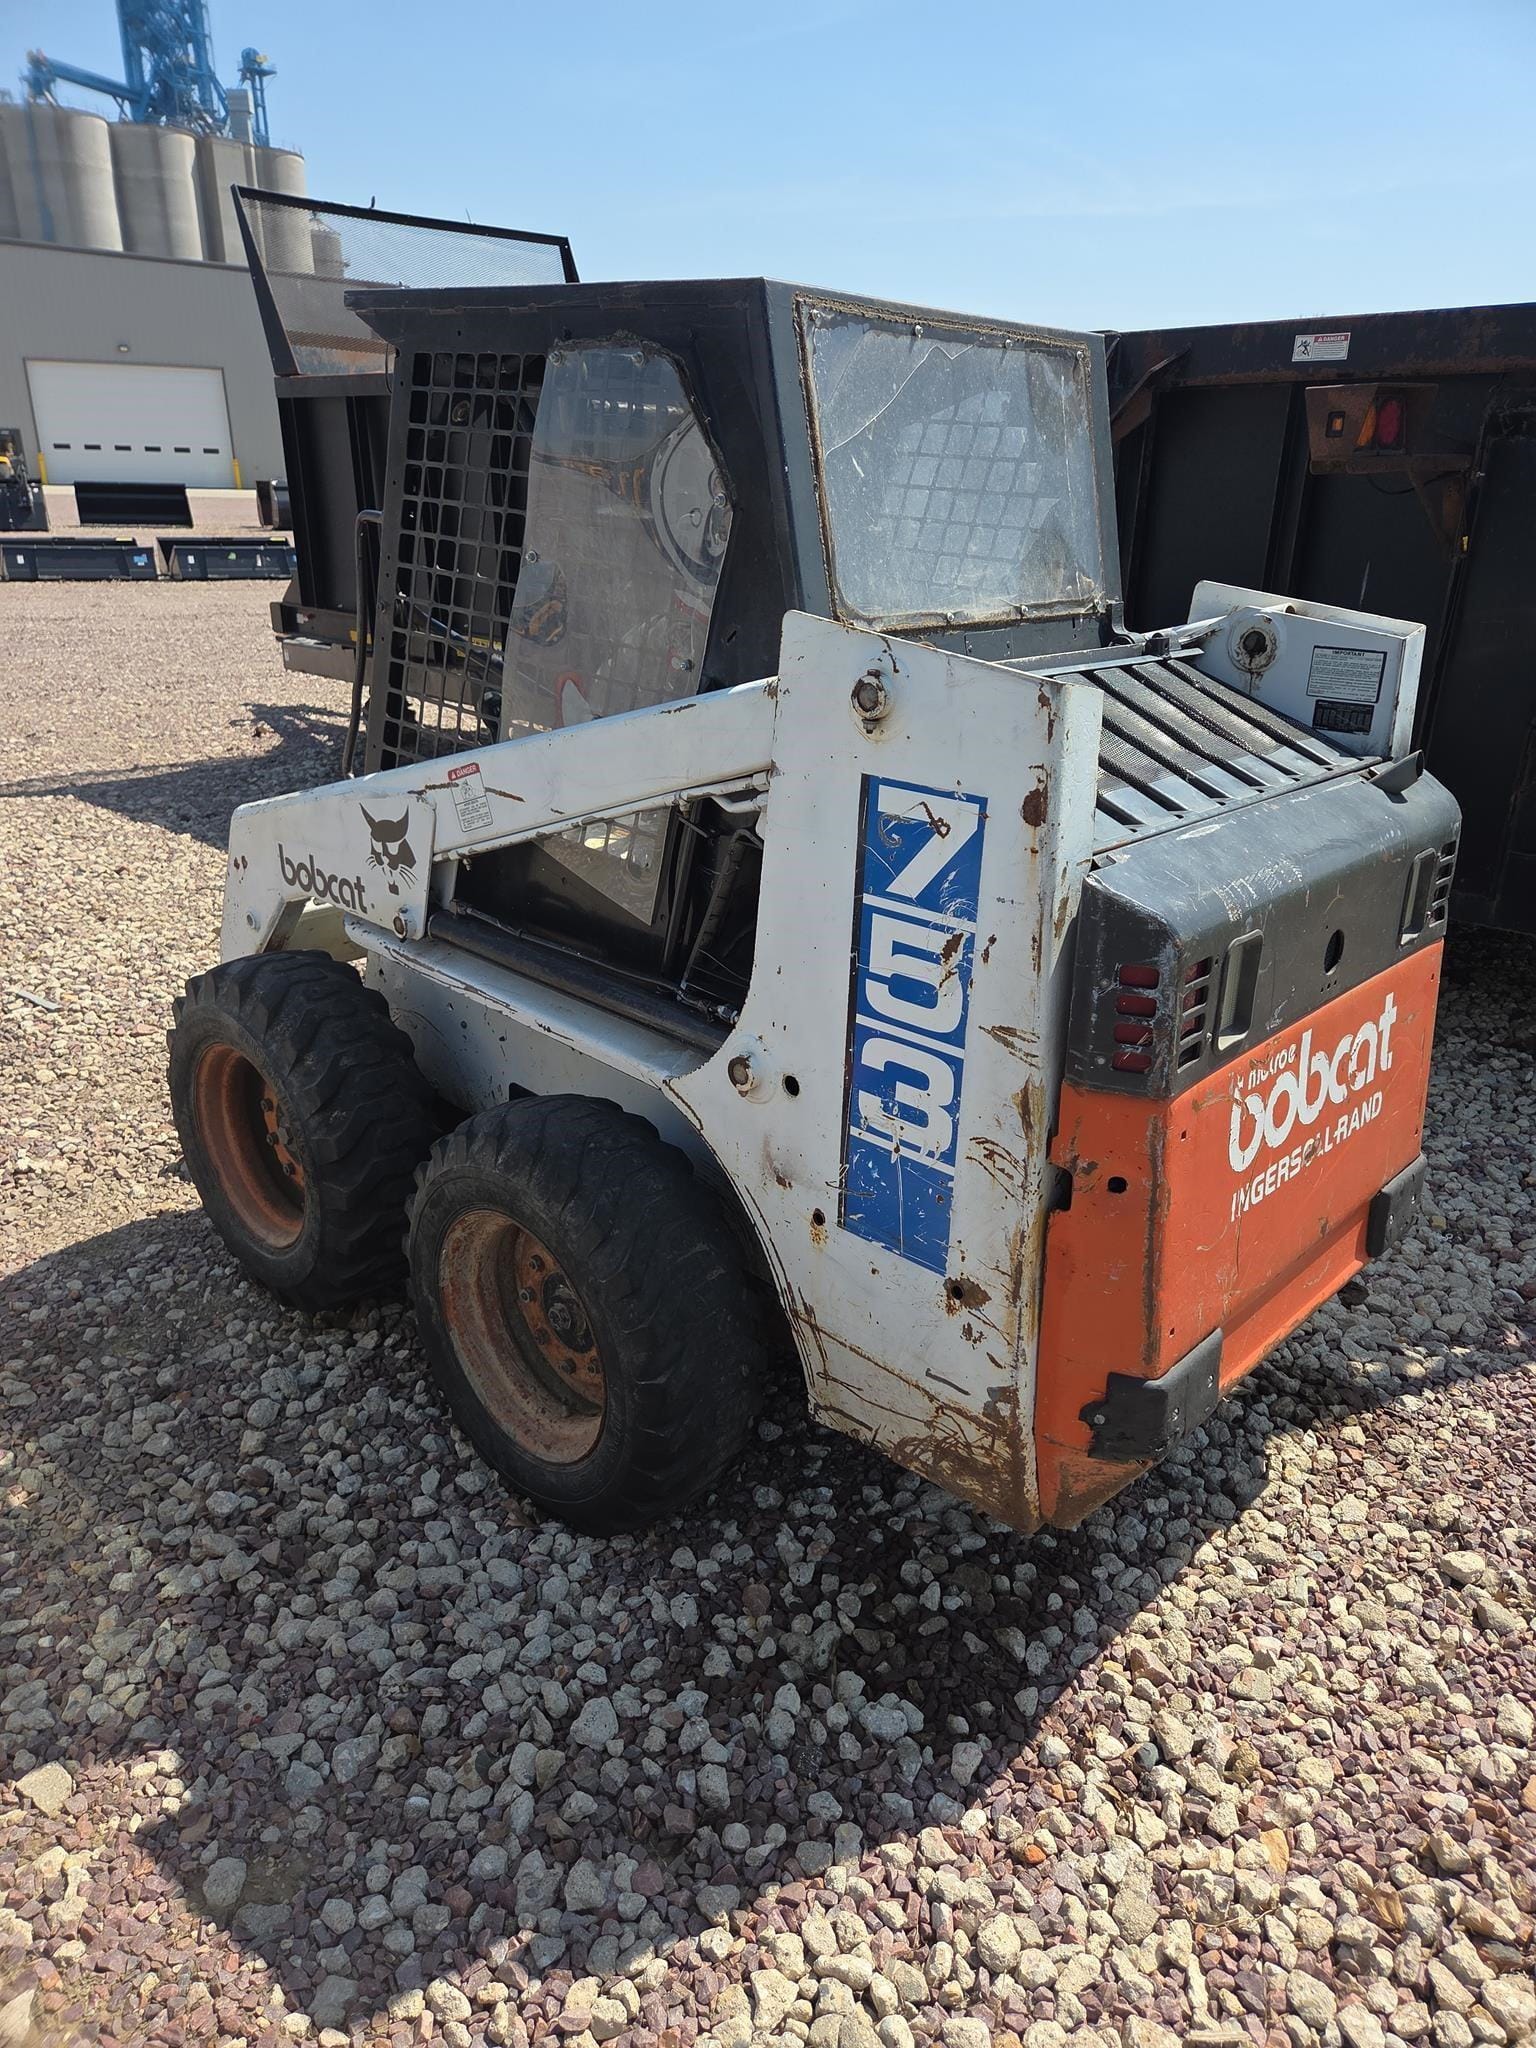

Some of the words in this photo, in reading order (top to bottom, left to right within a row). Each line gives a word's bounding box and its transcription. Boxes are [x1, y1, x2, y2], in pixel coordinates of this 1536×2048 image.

[456, 764, 477, 777] DANGER
[278, 843, 368, 914] bobcat
[1228, 991, 1398, 1173] bobcat
